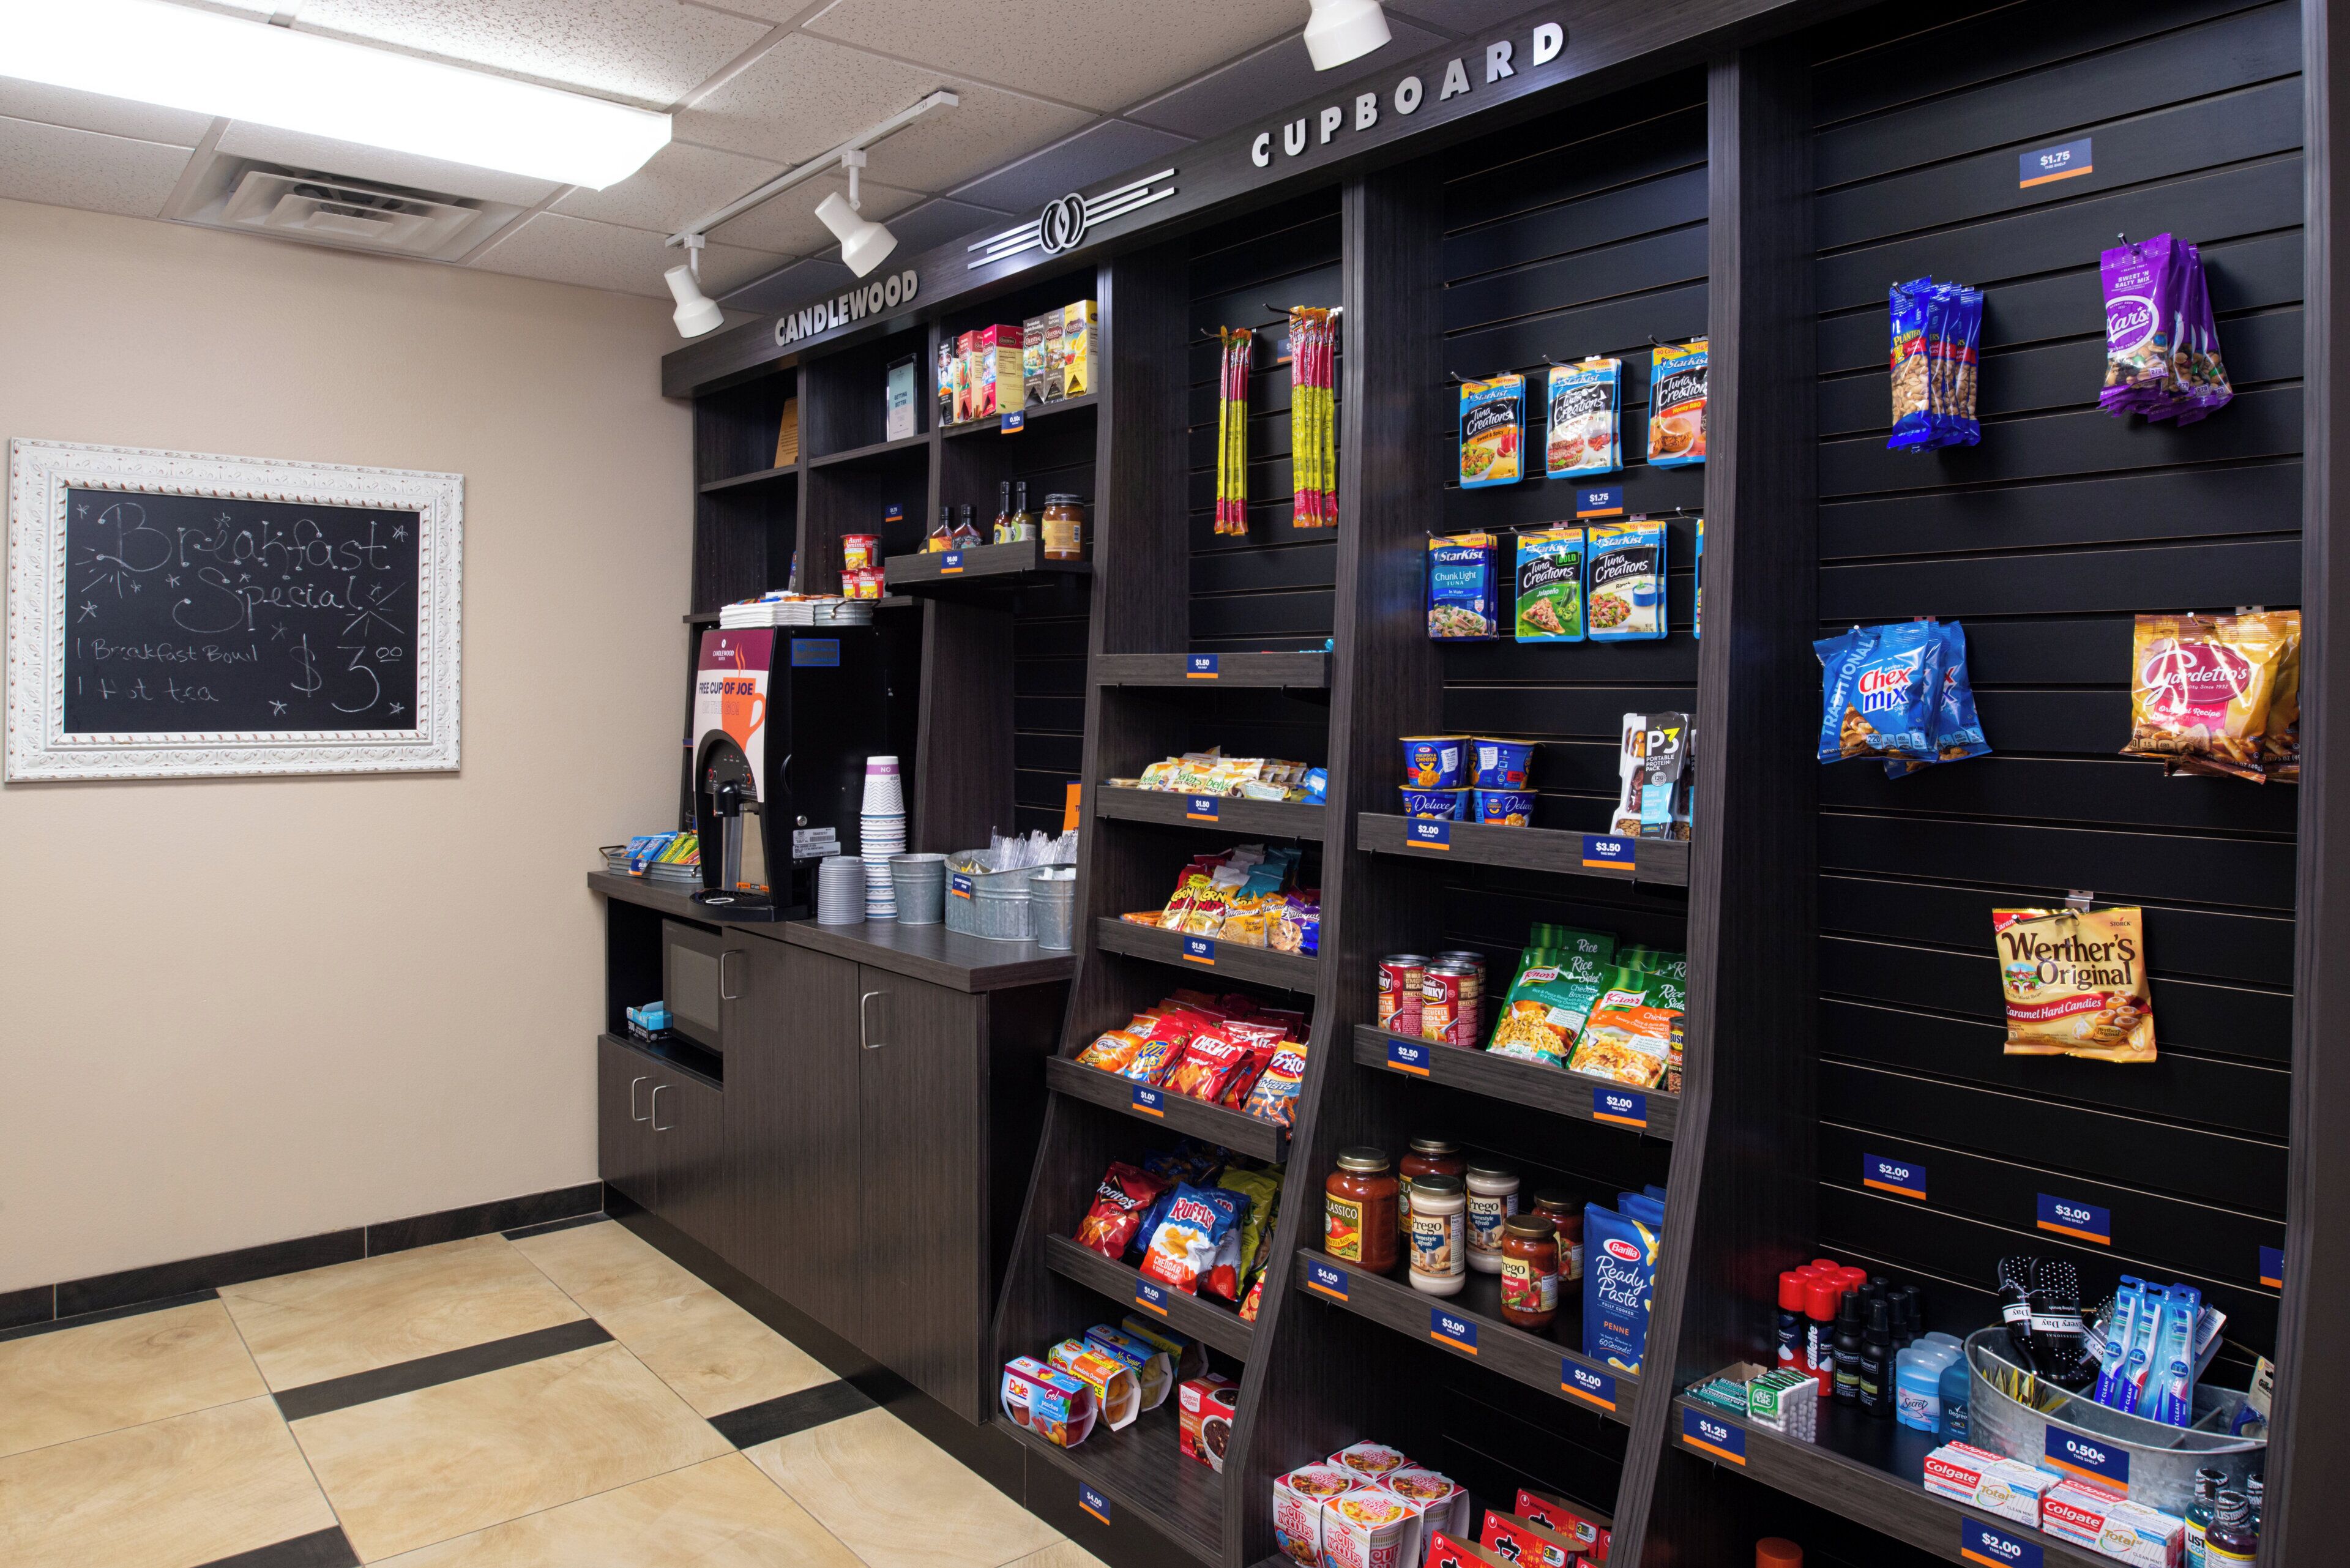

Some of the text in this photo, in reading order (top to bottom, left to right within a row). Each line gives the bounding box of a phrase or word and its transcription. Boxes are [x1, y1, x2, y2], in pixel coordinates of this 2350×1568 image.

[1252, 23, 1564, 167] CUPBOARD
[2040, 151, 2070, 166] $1.75
[2118, 272, 2141, 282] SWEET
[775, 270, 917, 346] CANDLEWOOD
[1664, 376, 1690, 391] Tuna
[895, 399, 906, 408] BETTER
[1473, 390, 1508, 401] StarKist
[1471, 407, 1490, 421] Tuna
[1554, 398, 1603, 422] Creations
[1673, 405, 1688, 414] Honey
[1467, 411, 1512, 435] Creations
[1589, 493, 1608, 502] $1.75
[98, 502, 391, 579] Breakfast
[1603, 535, 1643, 547] StarKist
[1440, 549, 1484, 561] StarKist
[1600, 554, 1625, 569] Tuna
[1435, 570, 1476, 581] Chunk Light
[1528, 561, 1550, 574] Tuna
[1596, 560, 1648, 583] Creations
[1523, 566, 1573, 588] Creations
[172, 567, 362, 633] Special
[1537, 588, 1559, 597] Jalapeño
[92, 638, 197, 662] Breakfast
[207, 644, 258, 662] Bowl
[1859, 667, 1913, 693] Chex
[2141, 649, 2247, 706] Gardetto's
[99, 677, 154, 701] Hot
[169, 677, 219, 703] tea
[699, 682, 753, 695] FREE CUP OF JOE
[1822, 640, 1875, 736] TRADITIONAL
[1864, 686, 1908, 712] mix
[1646, 728, 1680, 756] P3
[1412, 795, 1451, 812] Deluxe
[1418, 825, 1439, 835] $2.00
[1595, 842, 1621, 853] $3.50
[1192, 942, 1206, 950] $1.50
[1577, 939, 1598, 953] Rice
[2001, 932, 2136, 962] Werther's
[1572, 956, 1593, 973] Rice
[1524, 971, 1555, 980] Knorr
[2036, 960, 2133, 991] Original
[2006, 998, 2102, 1018] Caramel Hard Candies
[1398, 1046, 1419, 1059] $2.50
[1141, 1091, 1155, 1102] $1.00
[1606, 1096, 1632, 1109] $2.00
[1879, 1163, 1909, 1178] $2.00
[1168, 1197, 1215, 1231] RUFFLES
[1469, 1197, 1499, 1215] Prego
[2055, 1204, 2091, 1222] $3.00
[1415, 1234, 1436, 1242] Homestyle
[1611, 1243, 1638, 1258] Barilla
[1154, 1256, 1181, 1274] CHEDDAR
[1318, 1267, 1338, 1283] $4.00
[1595, 1255, 1647, 1295] Ready
[1144, 1286, 1158, 1299] $1.00
[1598, 1277, 1638, 1308] Pasta
[1616, 1307, 1634, 1316] COOKED
[1442, 1318, 1465, 1334] $3.00
[1604, 1321, 1630, 1336] PENNE
[1807, 1326, 1818, 1370] Gillette
[1124, 1354, 1141, 1366] Sugar
[1575, 1369, 1601, 1387] $2.00
[1009, 1378, 1028, 1397] Dole
[1045, 1389, 1059, 1402] Gel
[1182, 1391, 1198, 1402] Duncan
[1756, 1396, 1770, 1406] tac
[1903, 1398, 1928, 1410] Secret
[1042, 1401, 1059, 1412] peaches
[1949, 1409, 1968, 1419] Degree
[1699, 1420, 1727, 1439] $1.25
[2067, 1441, 2106, 1463] 0.50¢
[2084, 1457, 2098, 1465] SHELF
[1926, 1461, 1977, 1484] Colgate
[1980, 1485, 2010, 1500] Total
[2065, 1479, 2121, 1501] Colgate
[1087, 1491, 1102, 1507] $4.00
[1286, 1506, 1306, 1524] CUP
[2045, 1502, 2101, 1527] Colgate
[1278, 1511, 1314, 1540] NOODLES
[1335, 1531, 1356, 1550] CUP
[1982, 1533, 2021, 1557] $2.00
[1327, 1536, 1362, 1568] NOODLES
[2000, 1550, 2013, 1559] SHELF
[2133, 1551, 2162, 1565] CLEAN MINT
